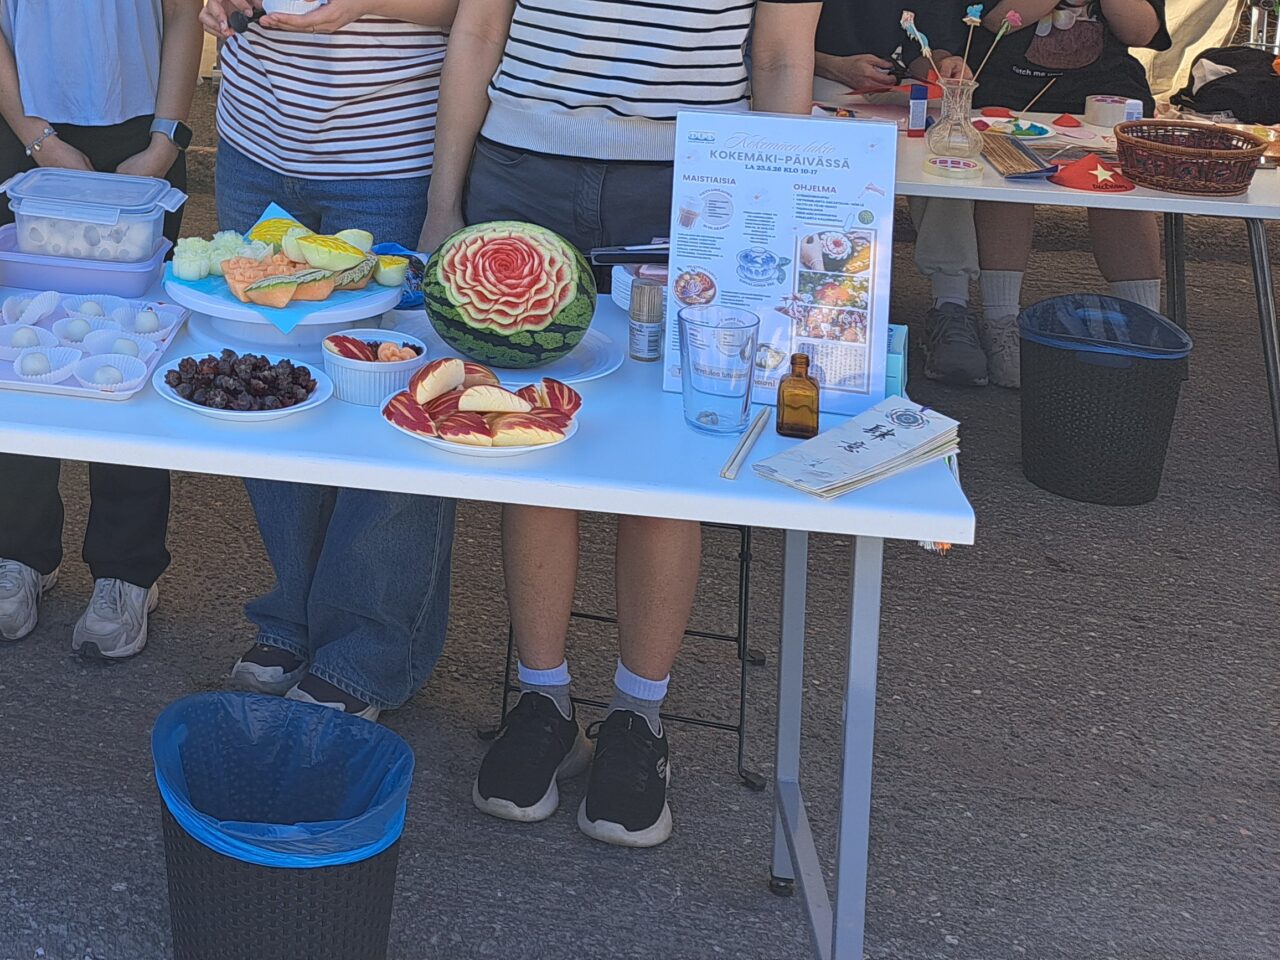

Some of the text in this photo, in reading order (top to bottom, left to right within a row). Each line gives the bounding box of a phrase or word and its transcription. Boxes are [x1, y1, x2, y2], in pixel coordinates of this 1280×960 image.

[710, 149, 851, 170] KOKEMÄKI-PÄIVÄSSÄ
[682, 174, 736, 185] MAISTIAISIA
[793, 183, 837, 193] OHJELMA
